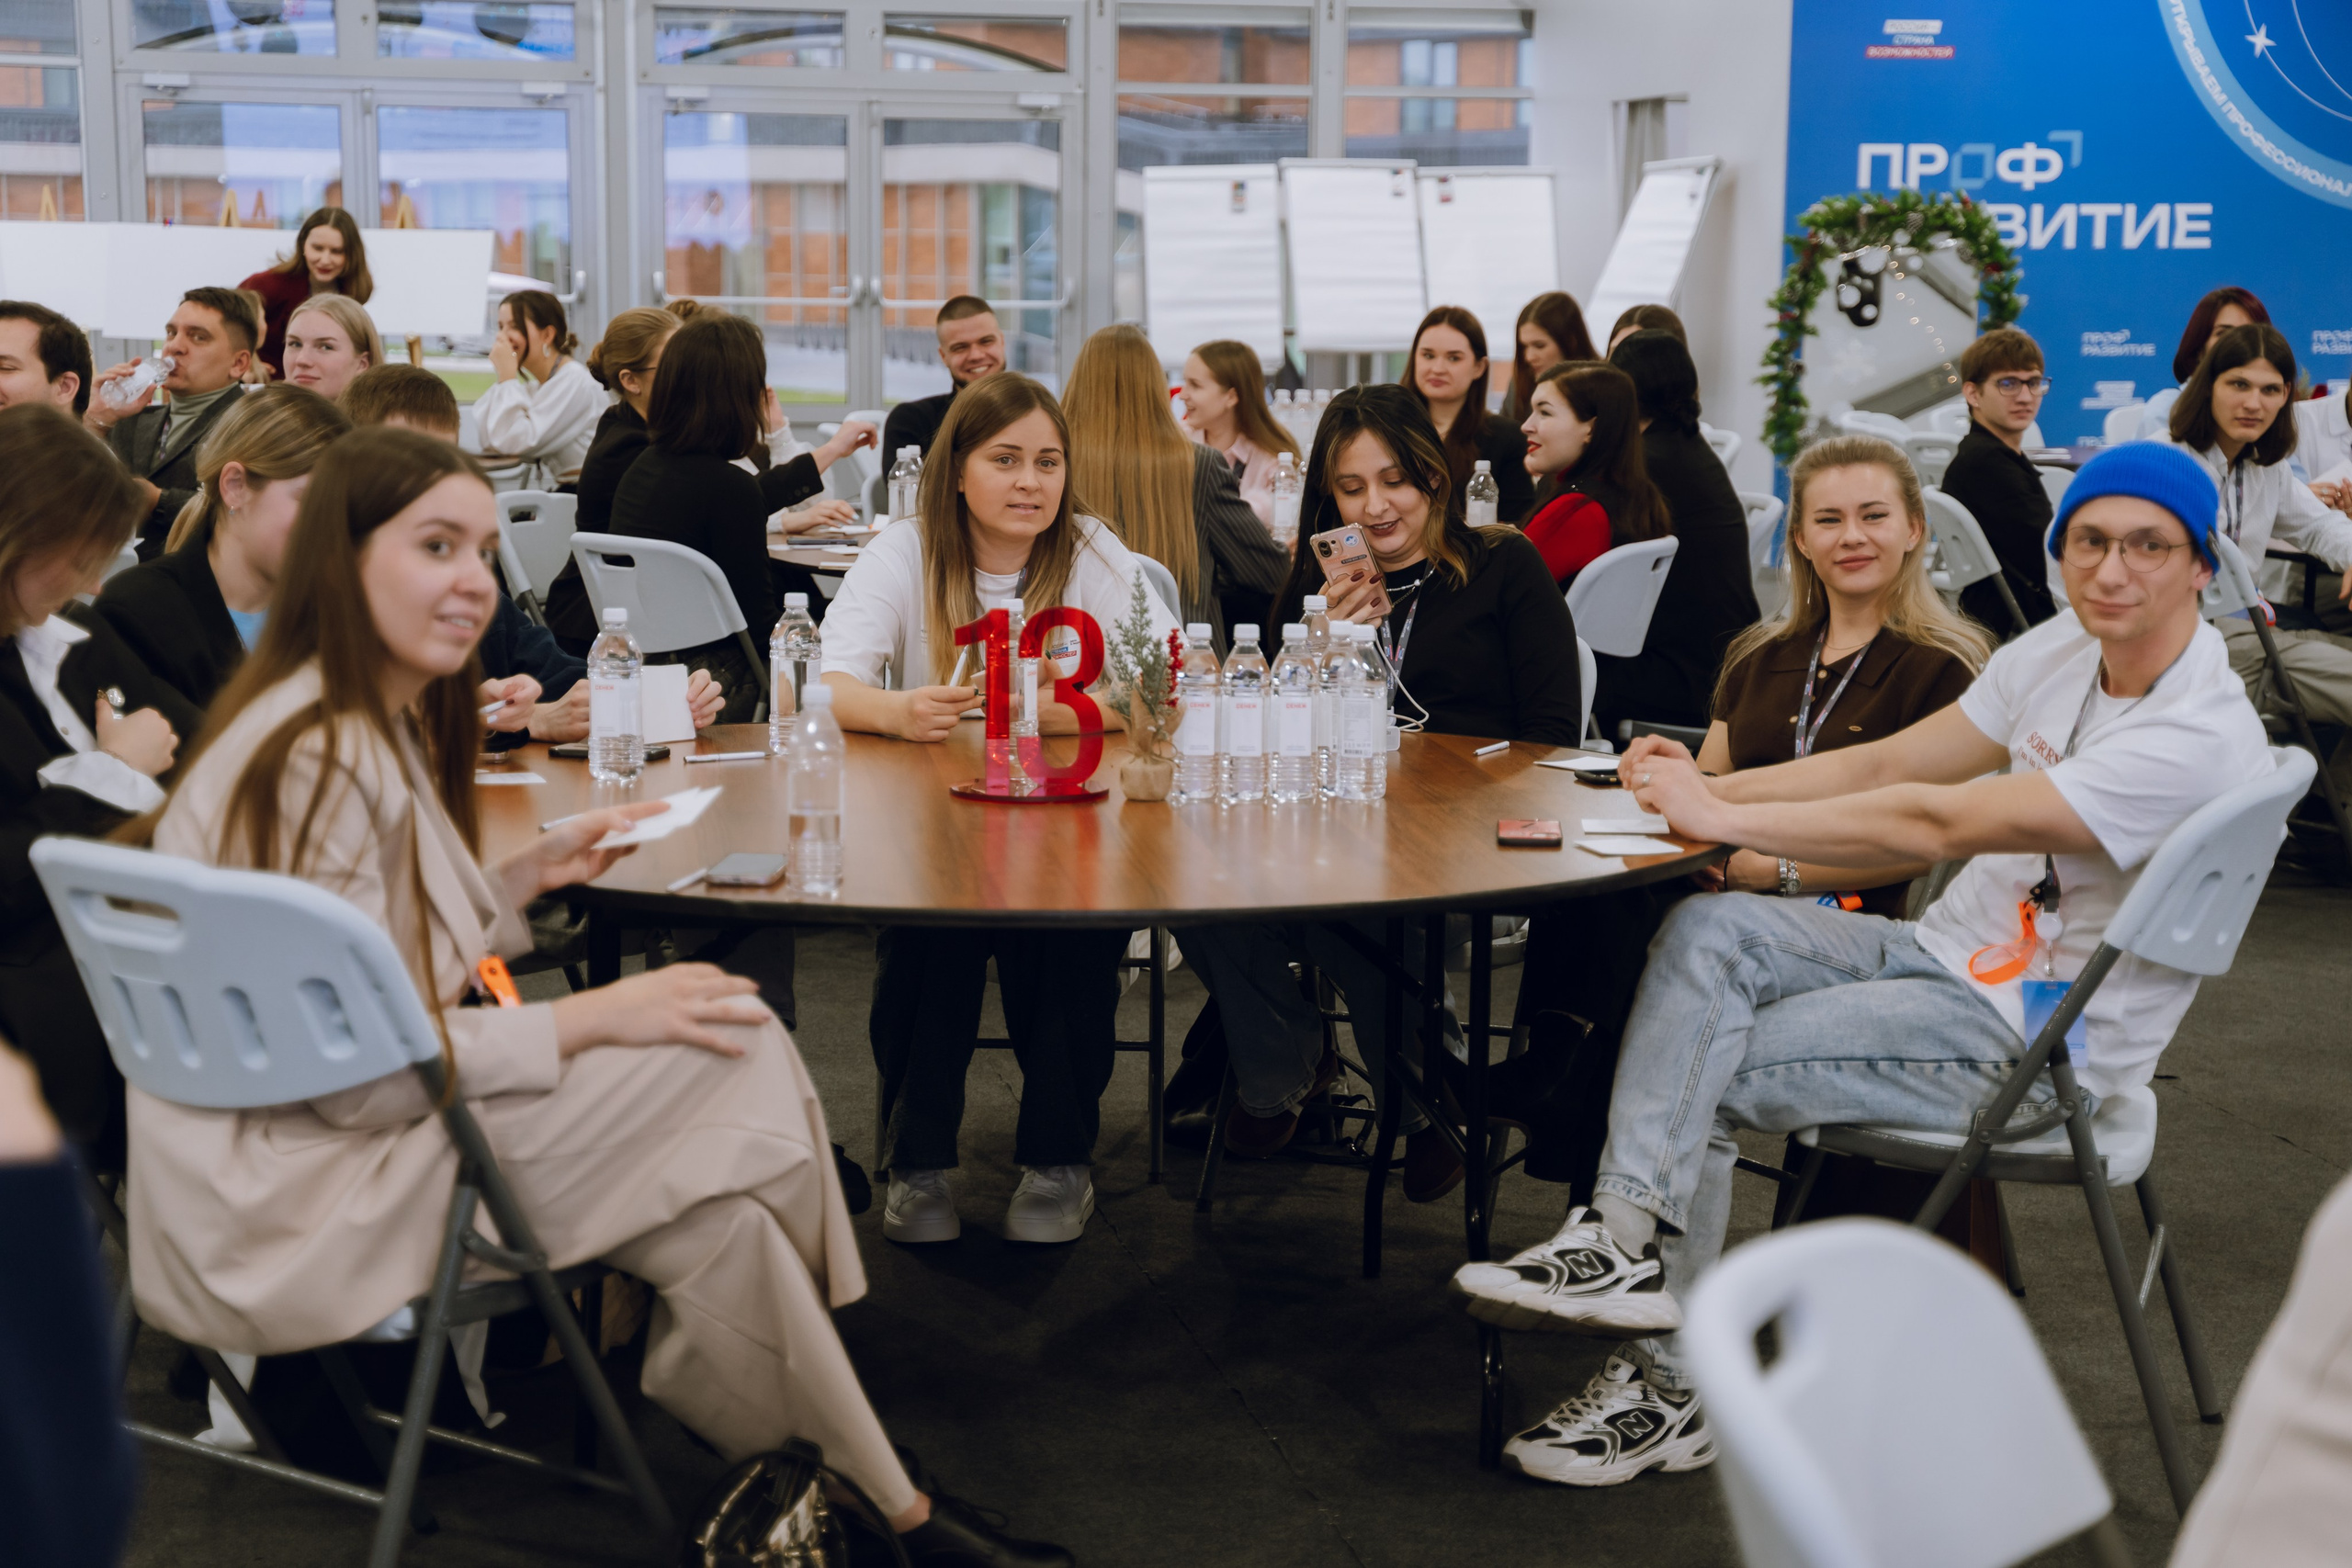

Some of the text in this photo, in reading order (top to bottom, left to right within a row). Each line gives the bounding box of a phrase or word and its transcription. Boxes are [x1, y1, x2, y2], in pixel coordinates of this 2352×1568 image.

[2169, 0, 2229, 107] ТКРЫВАЕМ
[1984, 202, 2213, 250] ВИТИЕ
[955, 606, 1105, 788] 13
